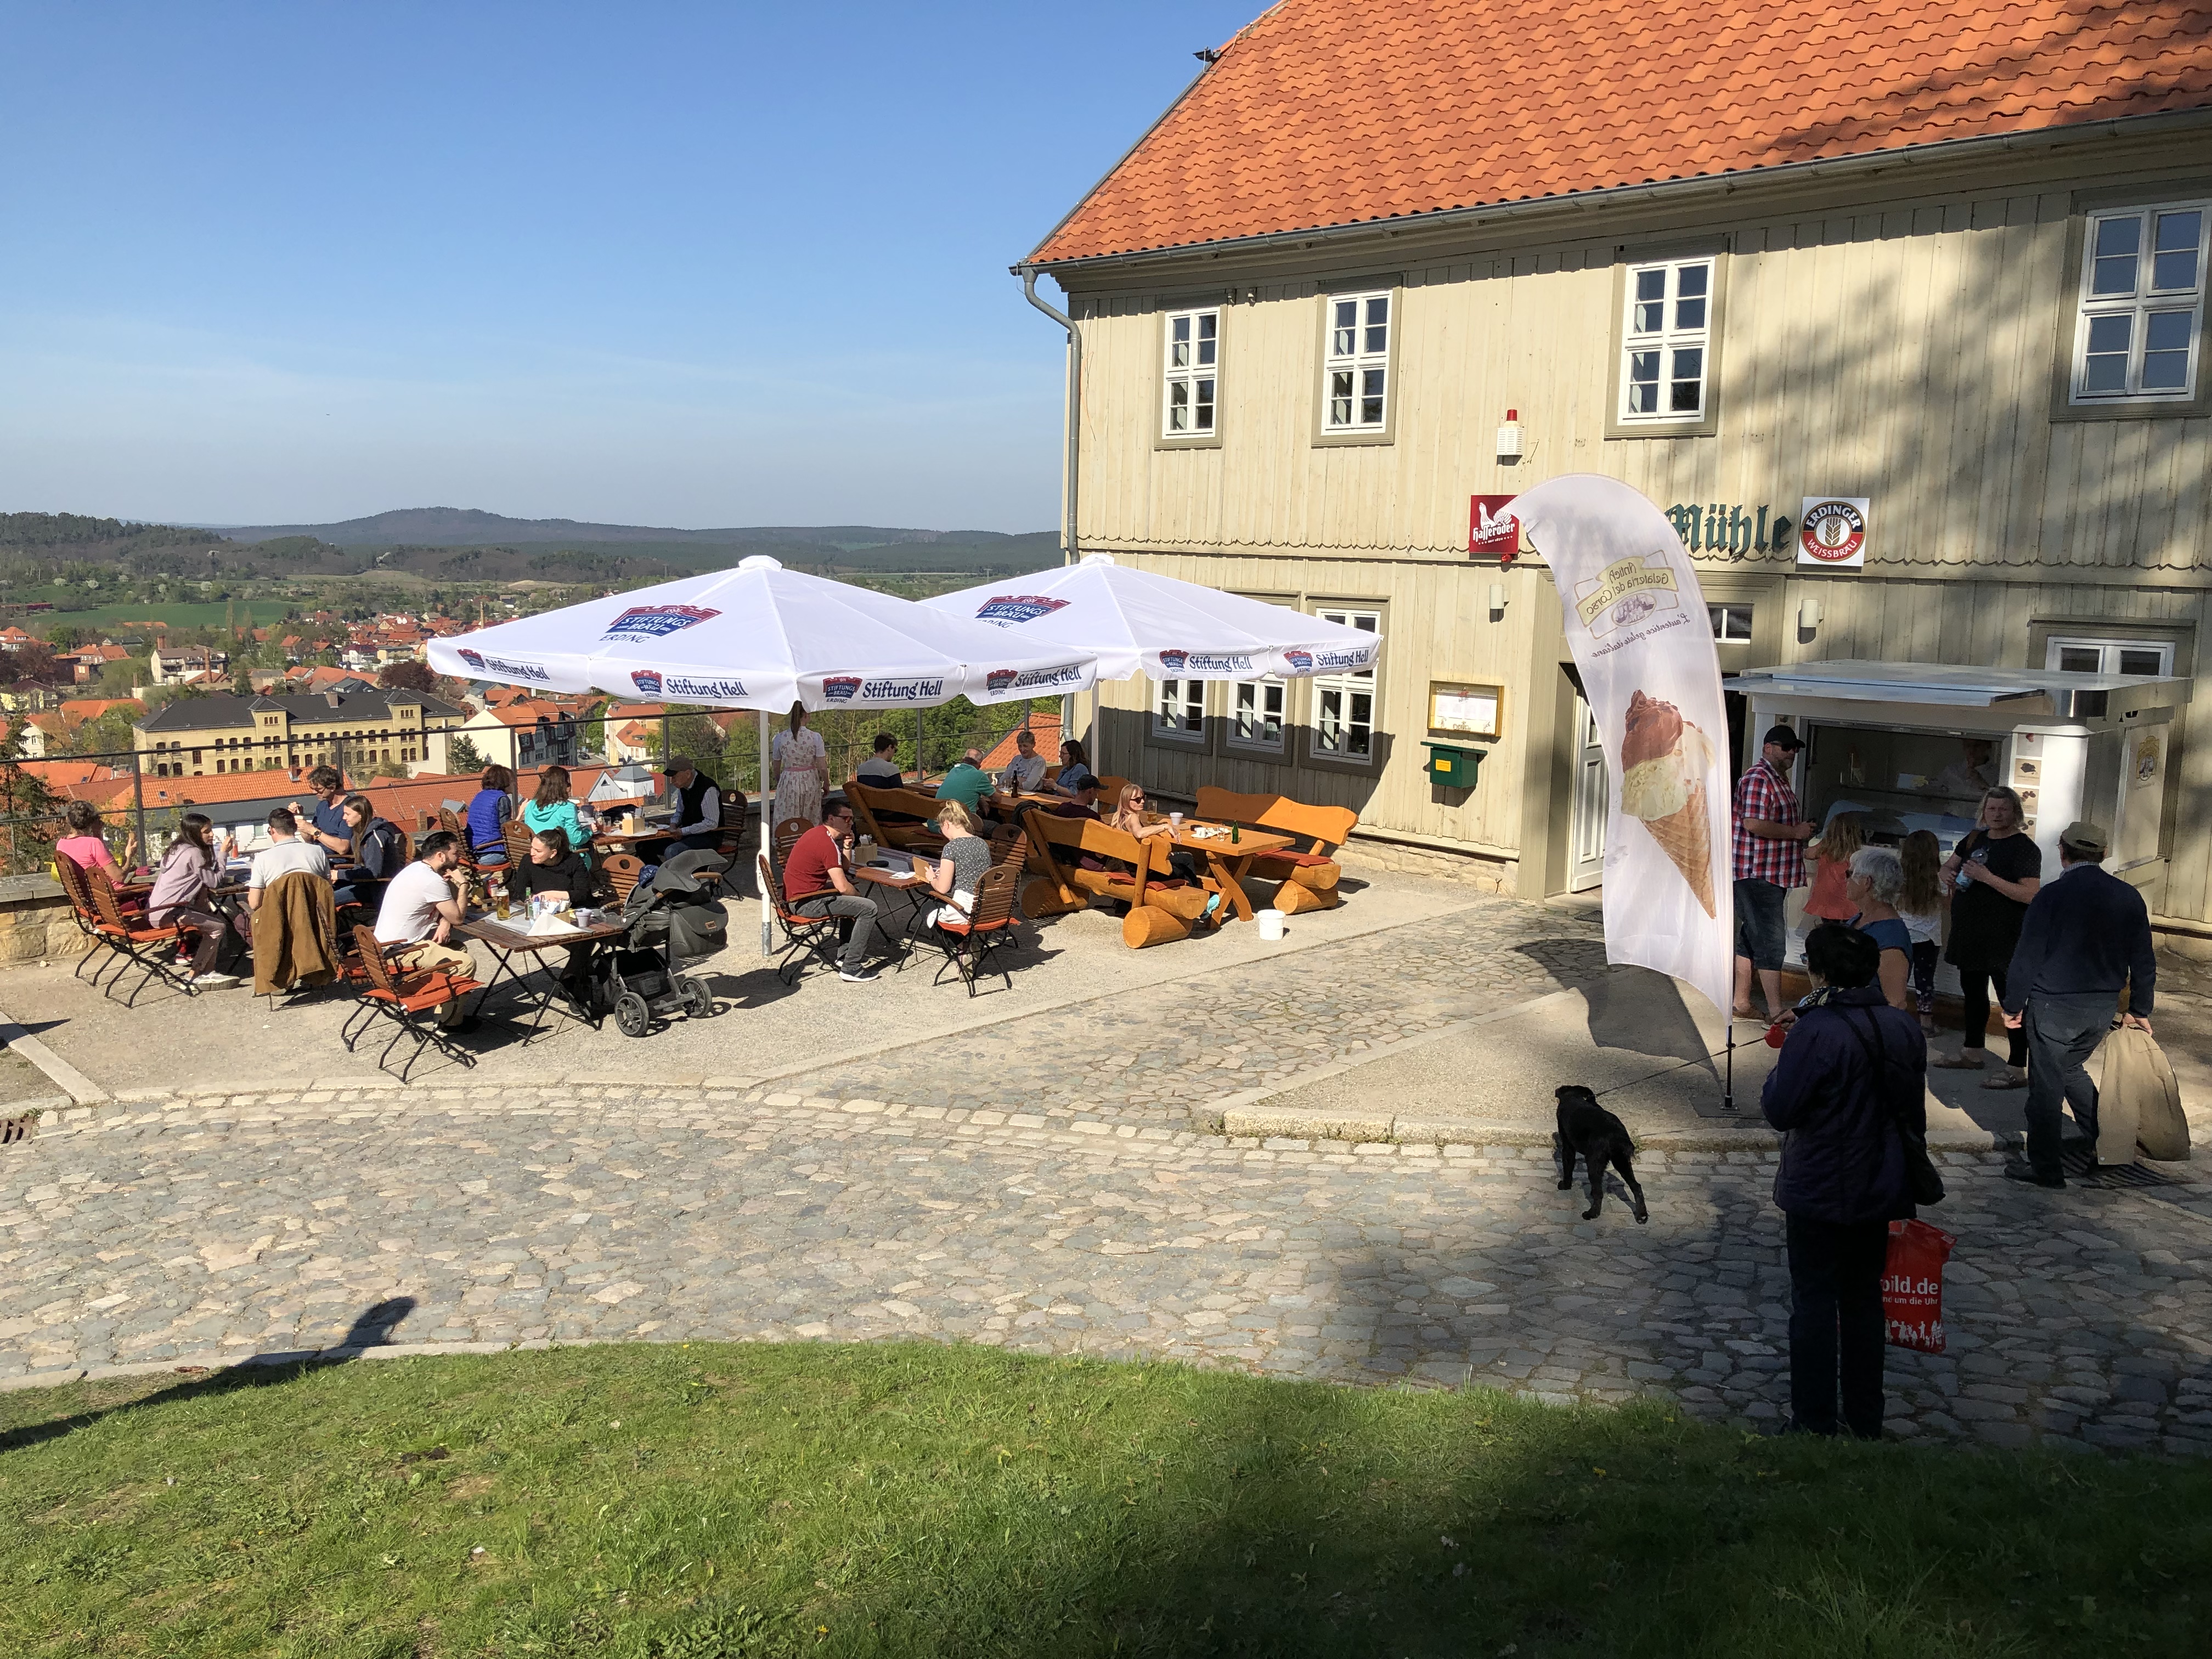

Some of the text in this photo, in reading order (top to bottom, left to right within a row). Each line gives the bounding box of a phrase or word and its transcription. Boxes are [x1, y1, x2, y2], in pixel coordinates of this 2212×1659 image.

[1806, 505, 1861, 529] ERDINGER
[1664, 504, 1792, 555] Mühle
[1807, 539, 1858, 557] WEISSBRÄU
[987, 605, 1046, 615] STIFTUNGS
[621, 616, 692, 628] STIFTUNGS
[627, 623, 664, 631] BRÄU
[978, 620, 1014, 628] DING
[599, 634, 650, 643] ERDING
[1189, 656, 1253, 673] Stiftung Hell
[1316, 650, 1369, 667] Stiftung Hell
[486, 658, 550, 680] Stiftung Hell
[1015, 665, 1082, 686] Stiftung Hell
[667, 678, 749, 699] Stiftung Hell
[862, 680, 943, 700] Stiftung Hell
